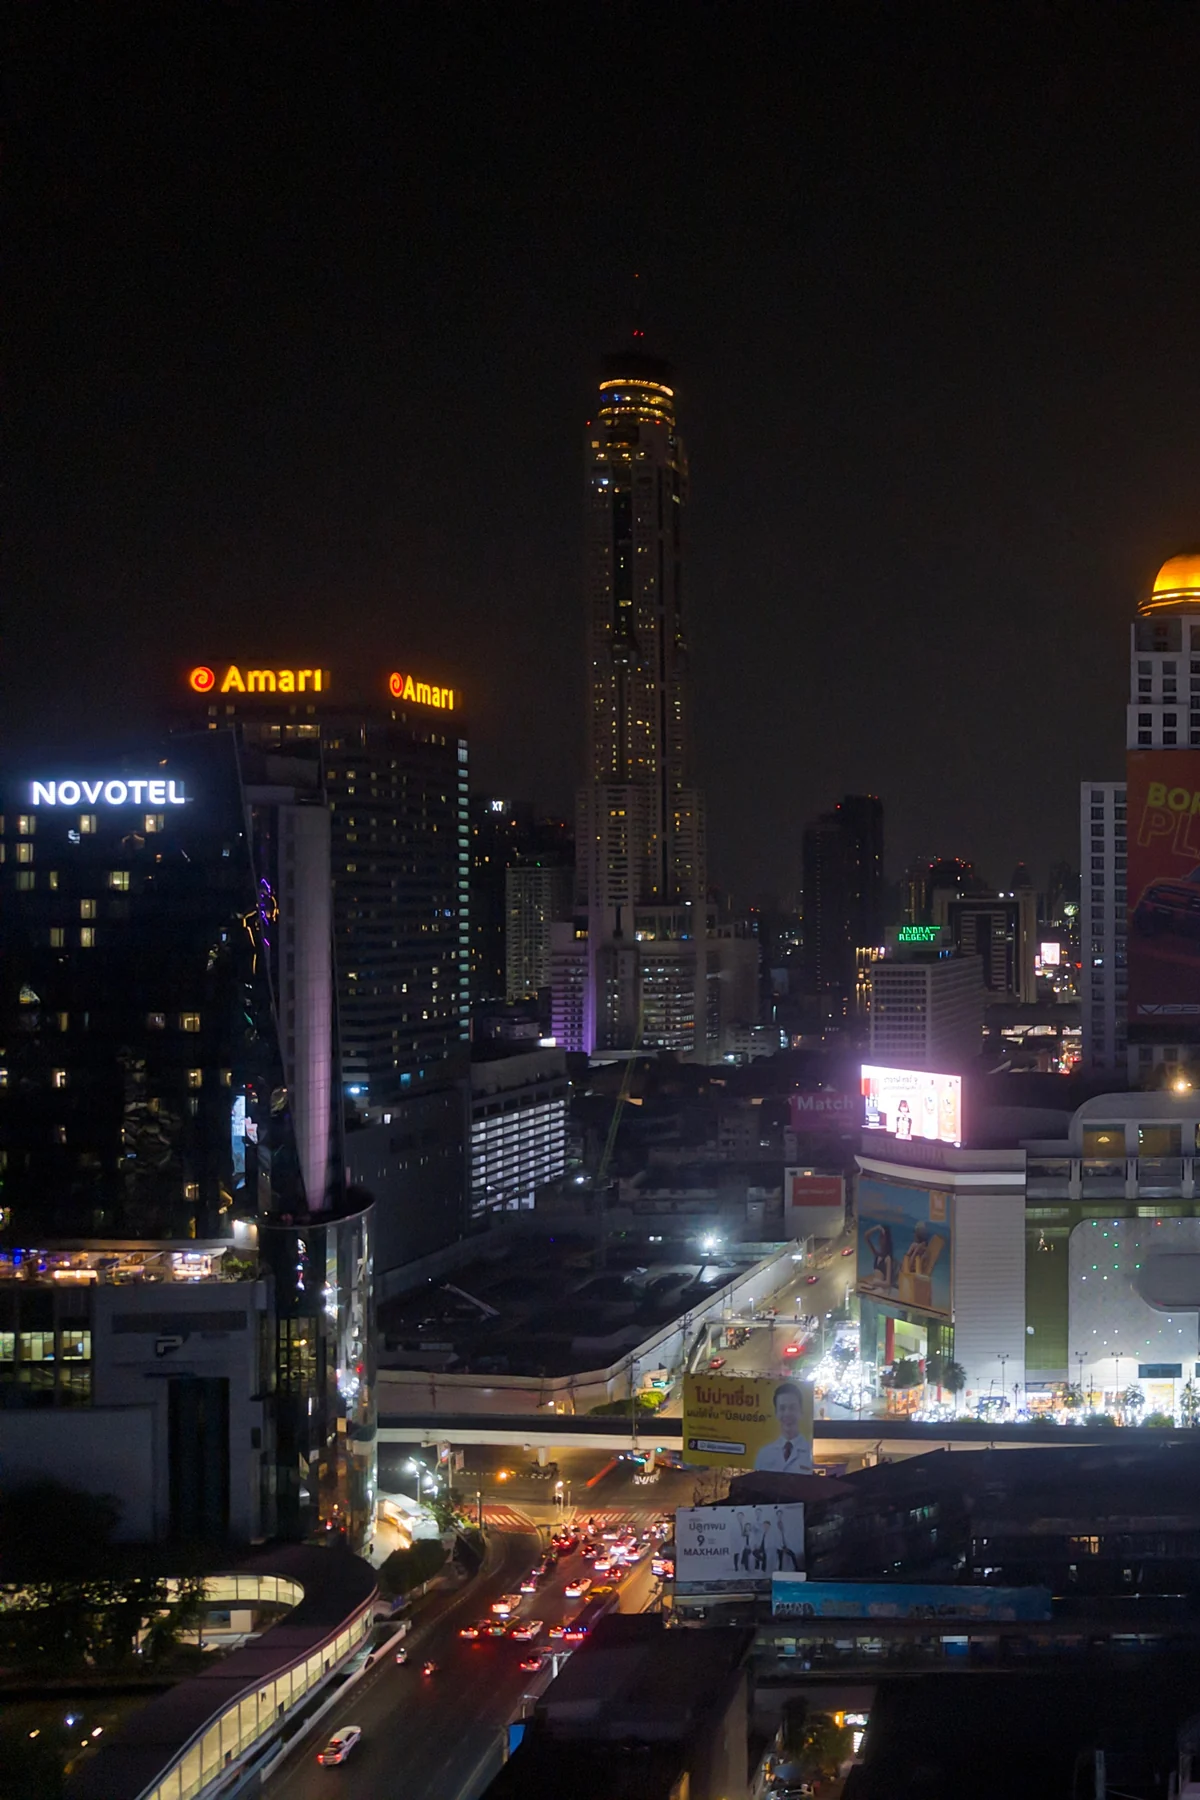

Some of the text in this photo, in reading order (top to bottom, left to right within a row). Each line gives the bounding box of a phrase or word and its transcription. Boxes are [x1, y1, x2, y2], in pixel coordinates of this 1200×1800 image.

[220, 665, 322, 693] Amari
[402, 675, 454, 711] Amari
[32, 780, 185, 805] NOVOTEL
[898, 933, 936, 941] REGENT
[902, 926, 931, 934] INDRA
[797, 1094, 854, 1111] Match
[696, 1534, 705, 1547] 9
[683, 1547, 730, 1557] MAXHAIR
